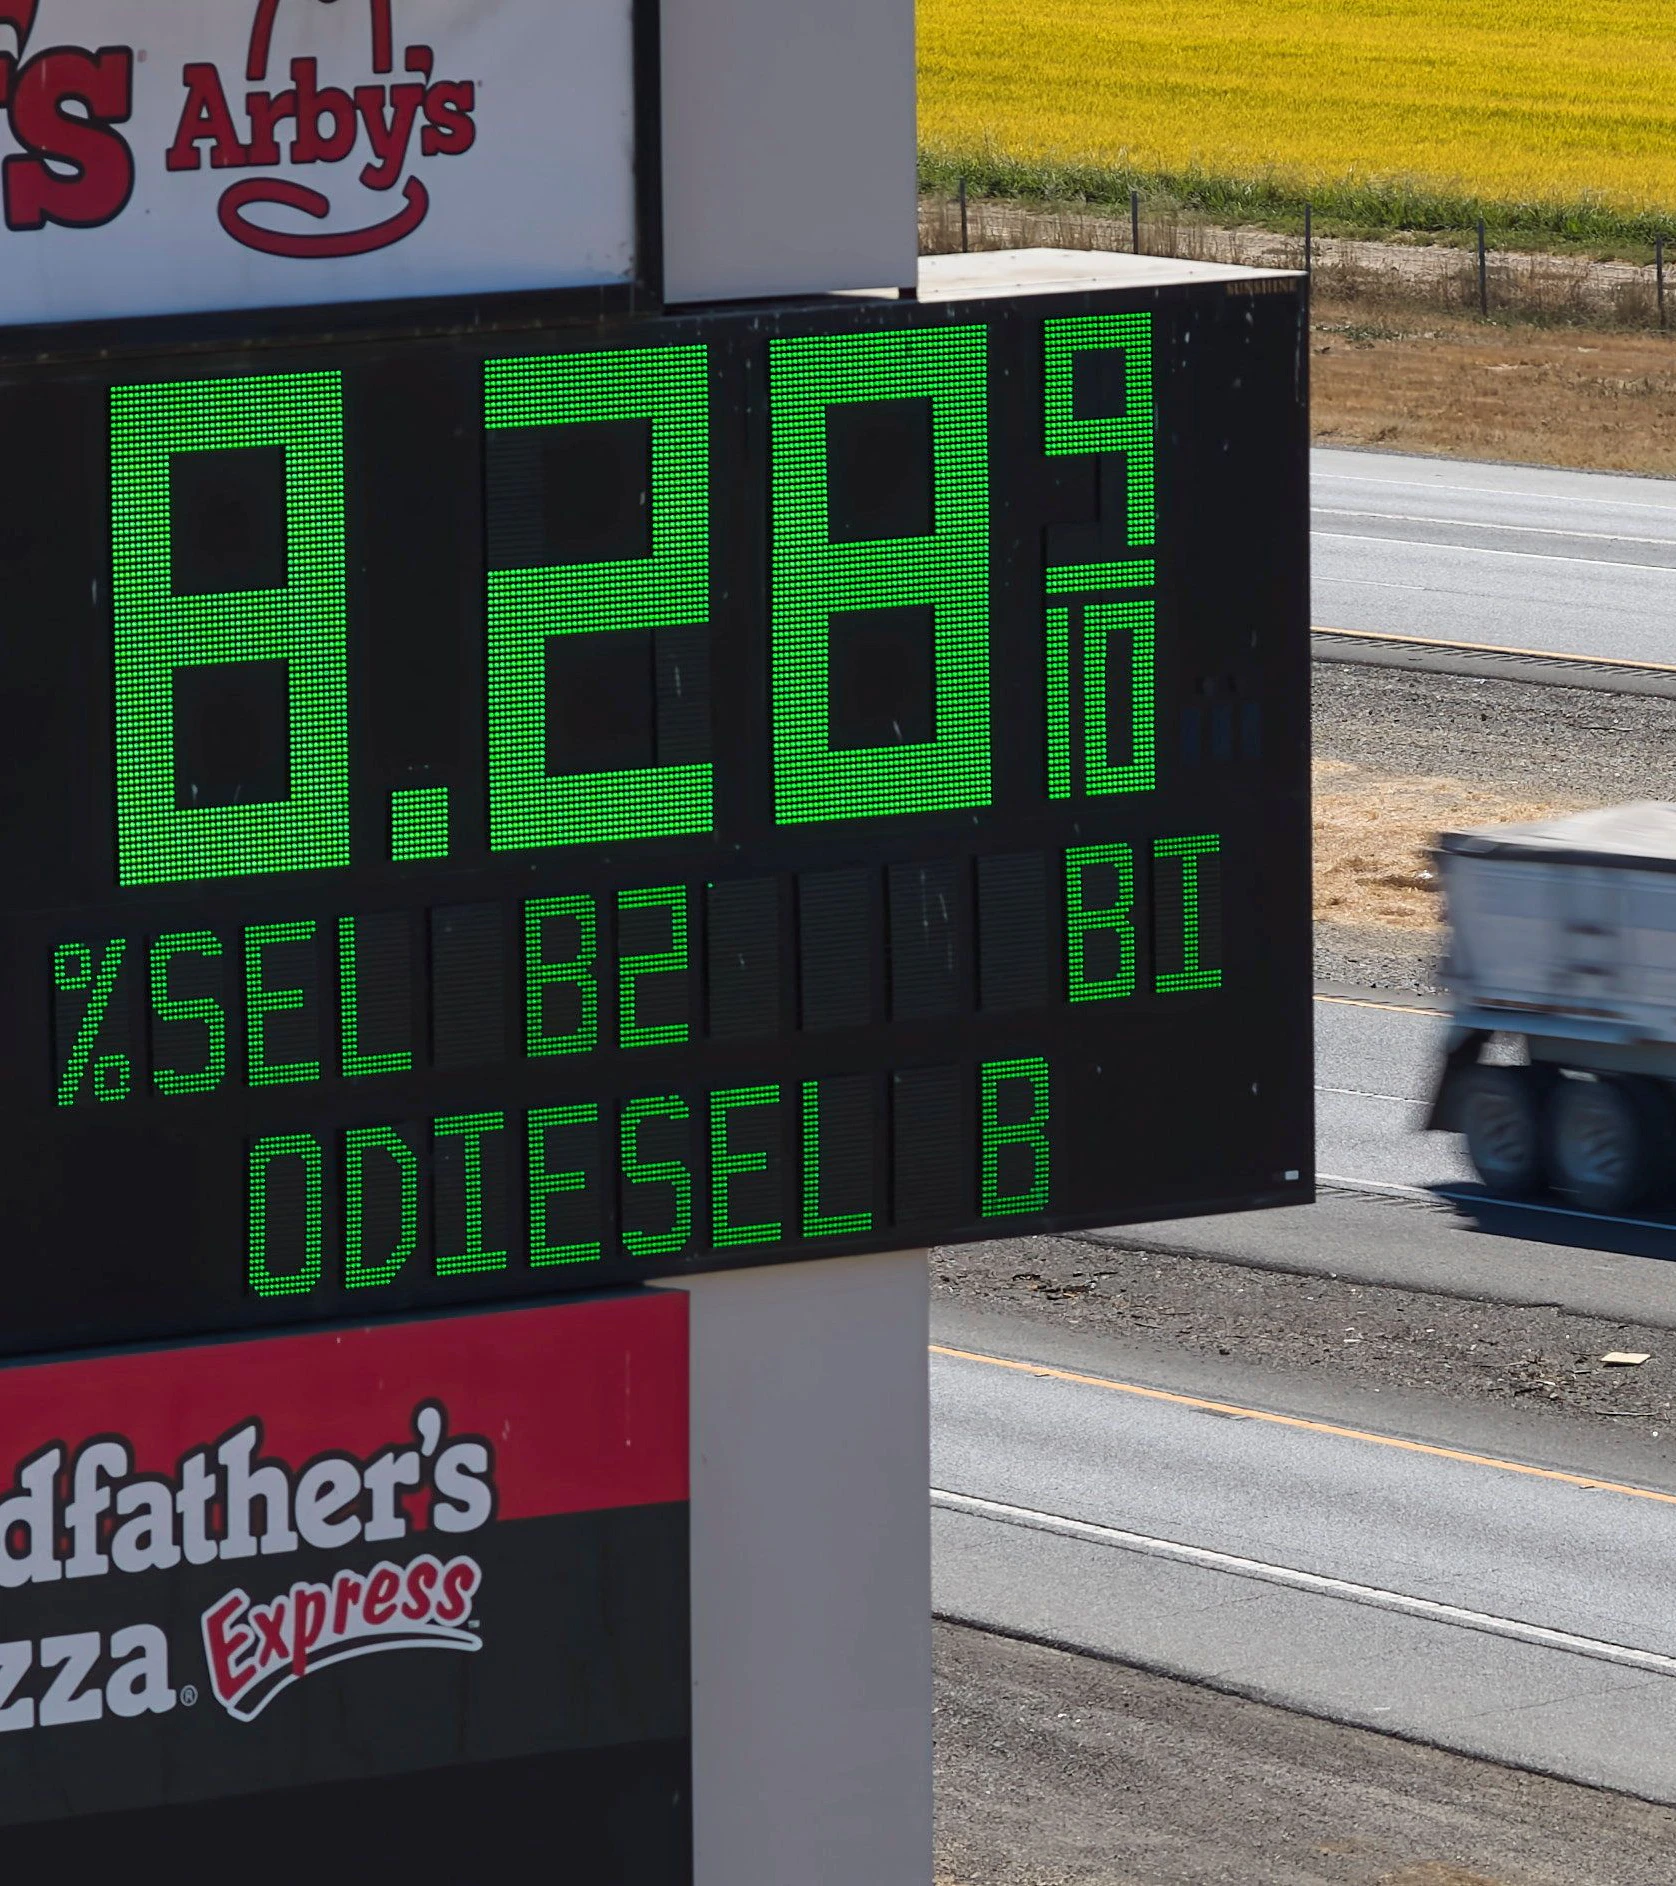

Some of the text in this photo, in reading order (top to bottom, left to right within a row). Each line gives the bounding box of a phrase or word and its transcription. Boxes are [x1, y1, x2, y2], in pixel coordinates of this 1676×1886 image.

[165, 45, 476, 191] Arby's
[110, 312, 1155, 887] 8.28 9
[1045, 600, 1156, 800] 10
[525, 885, 689, 1057] B2
[1065, 834, 1222, 1003] BI
[981, 1057, 1050, 1217] B
[202, 1554, 482, 1722] Express
